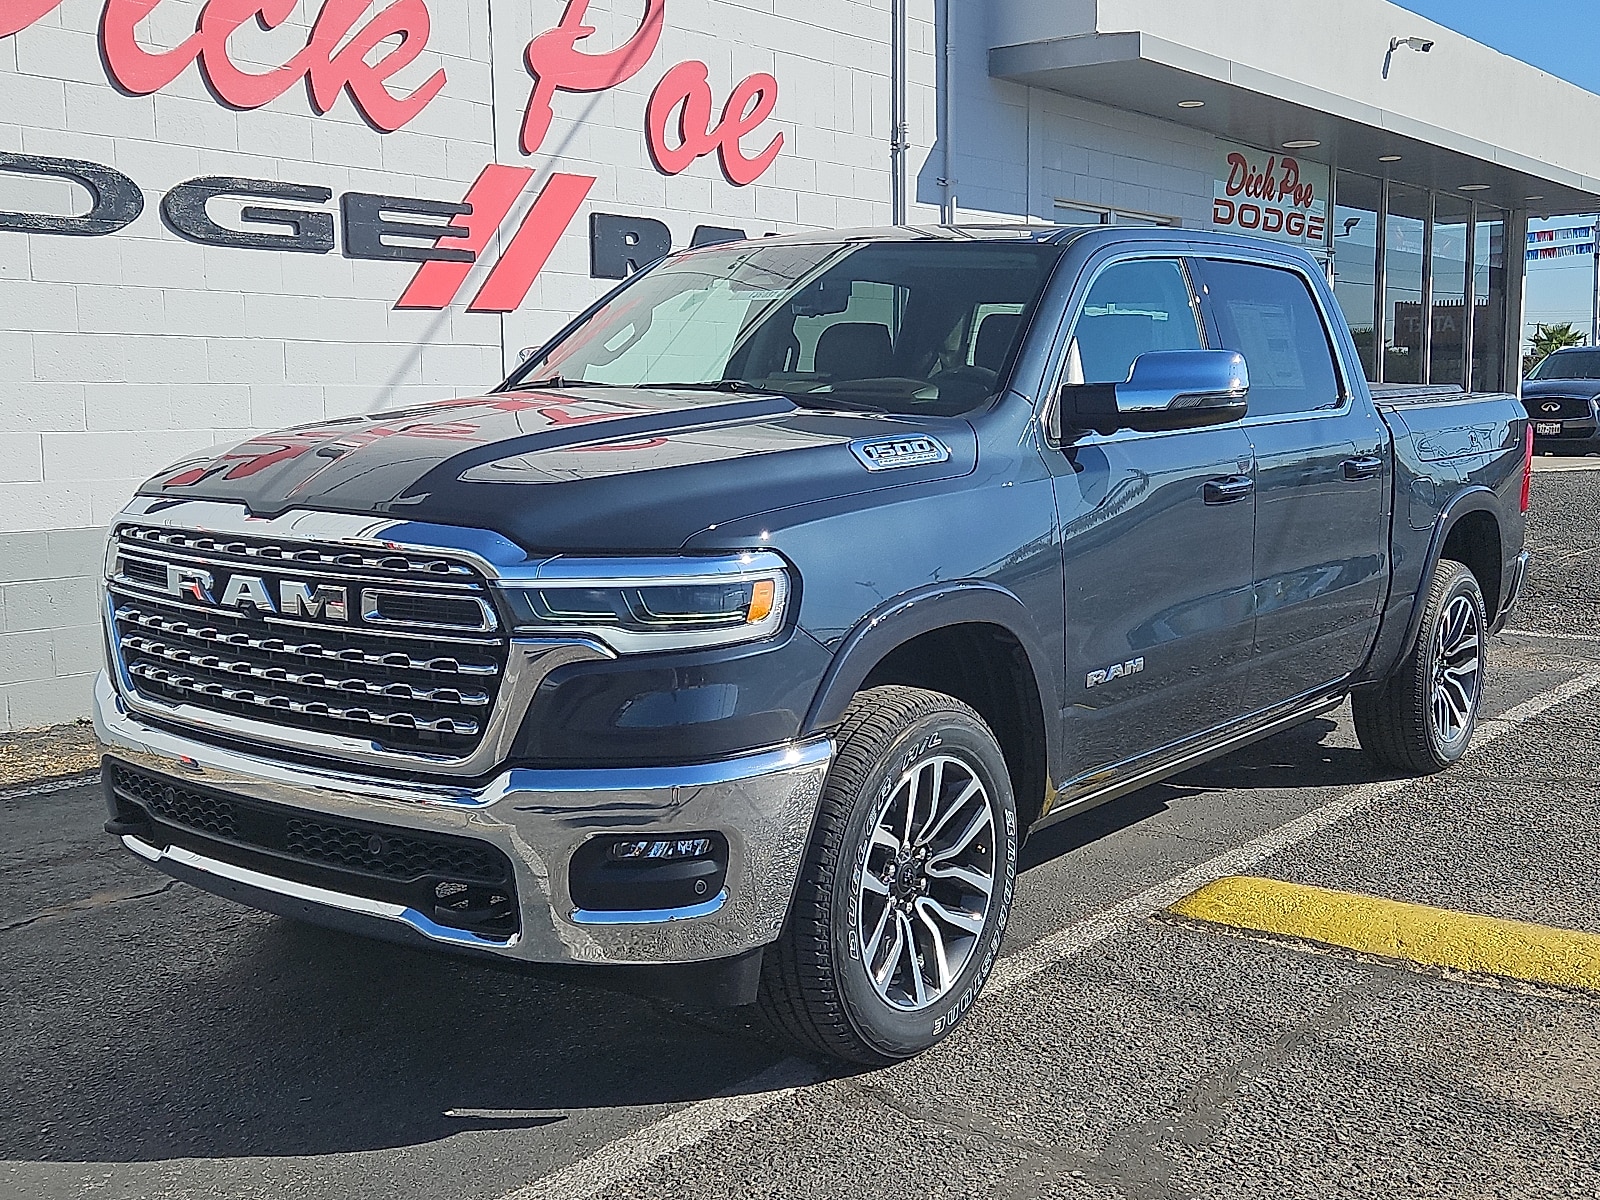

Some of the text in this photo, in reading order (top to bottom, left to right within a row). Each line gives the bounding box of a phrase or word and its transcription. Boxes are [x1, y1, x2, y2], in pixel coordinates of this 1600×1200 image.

[0, 0, 784, 187] ick Poe
[1226, 152, 1314, 208] Dick Poe
[1212, 197, 1326, 241] DODGE
[864, 440, 932, 459] 1500
[166, 563, 349, 622] RAM
[1085, 656, 1145, 689] RAM
[931, 808, 1017, 1037] BRIDGESTONE
